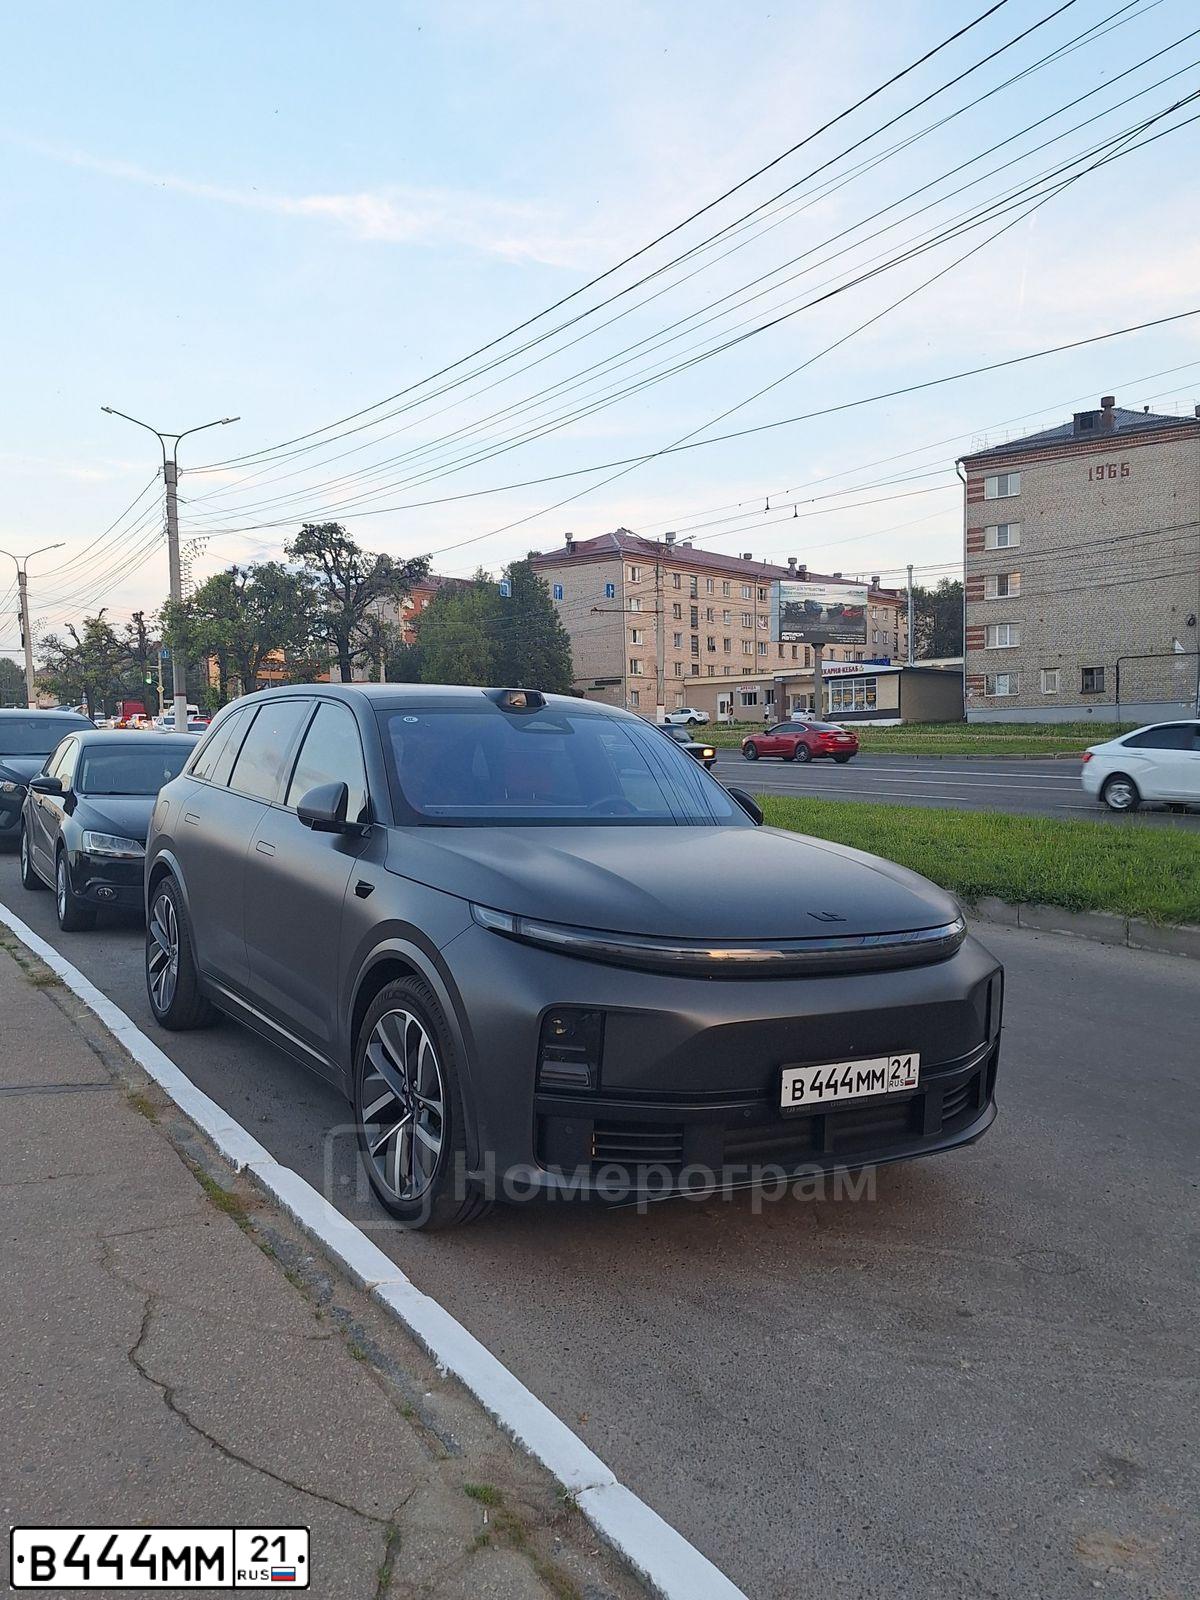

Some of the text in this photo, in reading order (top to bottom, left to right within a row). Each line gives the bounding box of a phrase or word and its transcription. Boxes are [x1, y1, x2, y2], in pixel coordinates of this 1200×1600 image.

[1088, 462, 1130, 481] 1965
[792, 1057, 912, 1101] В444ММ 21
[889, 1080, 905, 1088] RUS
